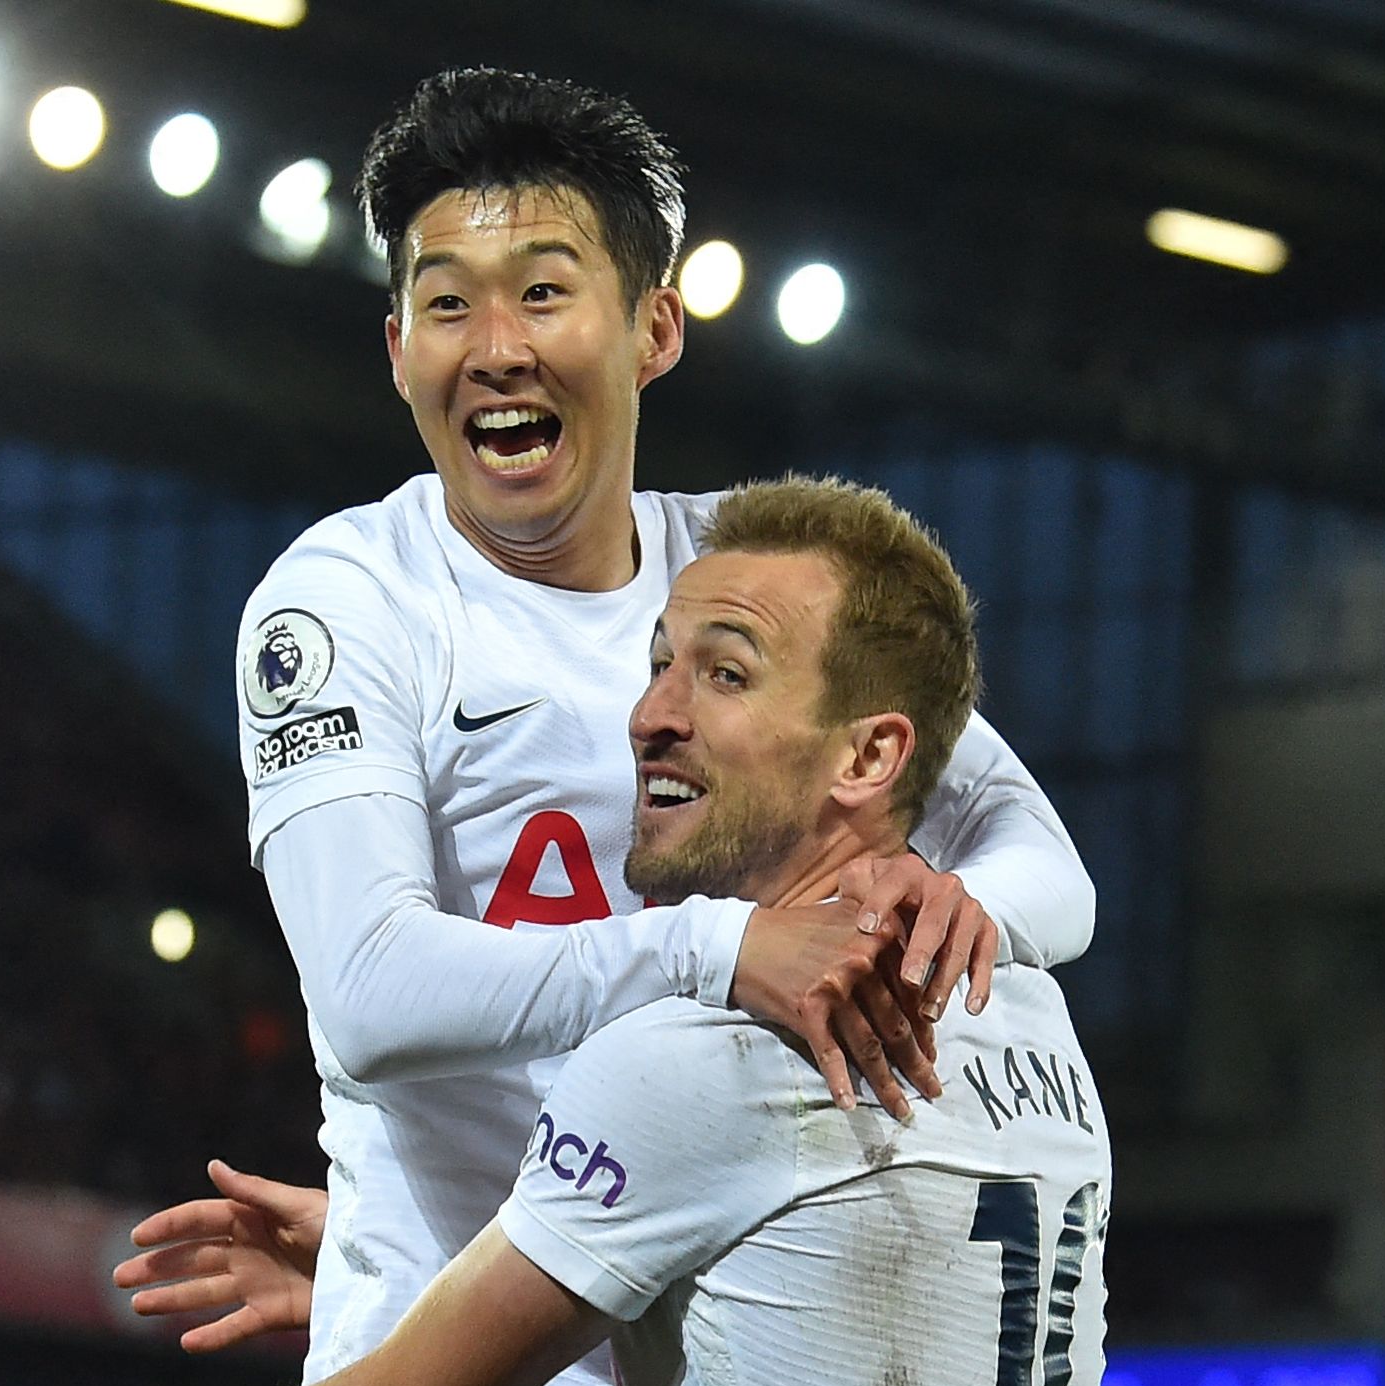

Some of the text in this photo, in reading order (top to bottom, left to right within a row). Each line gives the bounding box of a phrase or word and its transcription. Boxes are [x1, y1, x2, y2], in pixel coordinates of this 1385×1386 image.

[256, 713, 346, 761] No room
[285, 731, 362, 767] racism
[482, 808, 660, 931] A
[963, 1046, 1094, 1136] KANE
